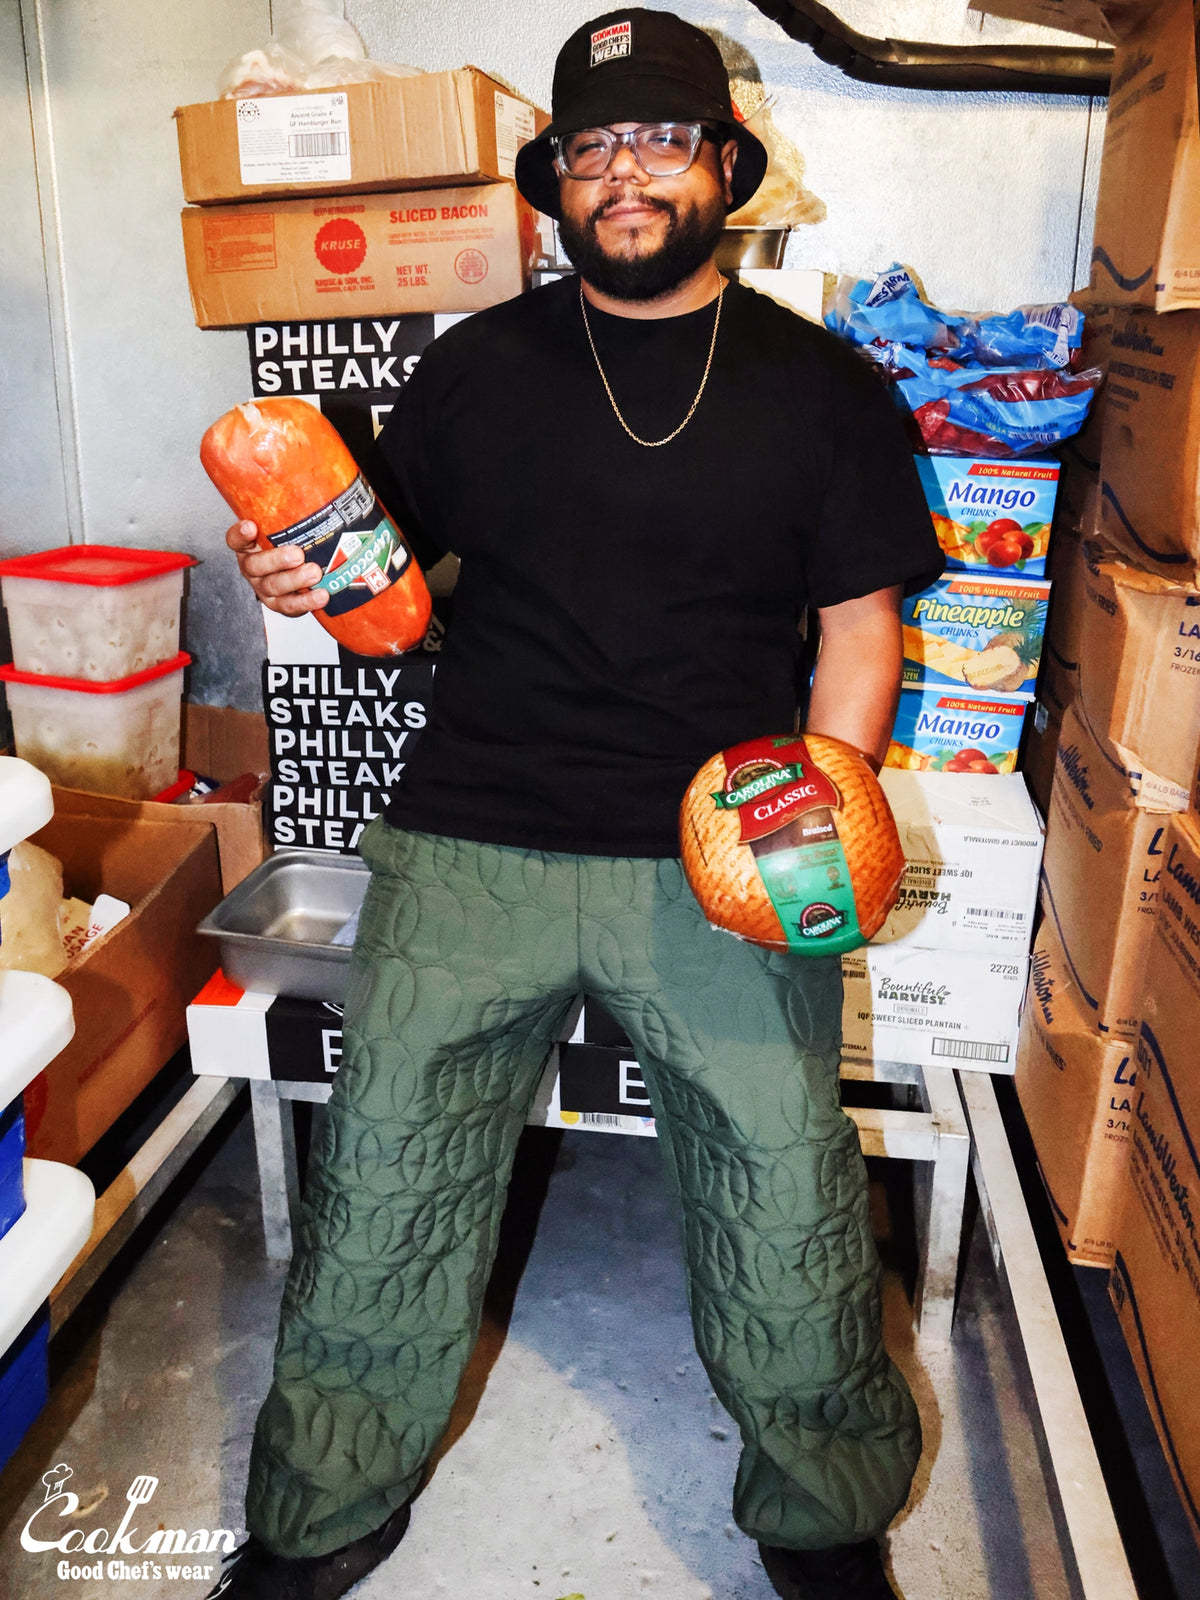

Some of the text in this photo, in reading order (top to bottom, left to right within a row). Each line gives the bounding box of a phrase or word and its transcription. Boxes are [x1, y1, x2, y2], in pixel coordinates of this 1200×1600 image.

[593, 24, 629, 43] COOKMAN
[594, 44, 628, 62] WEAR
[298, 119, 329, 127] Hamburger
[389, 204, 488, 224] SLICED BACON
[321, 239, 361, 251] KRUSE
[396, 264, 431, 275] NET WT.
[397, 276, 429, 288] 25 LBS.
[255, 321, 400, 357] PHILLY
[978, 466, 1053, 479] 100% Natural Fruit
[948, 482, 1036, 509] Mango
[960, 507, 998, 518] CHUNKS
[328, 529, 391, 591] CAPOCOLLO
[958, 584, 1040, 599] 100% Natural Fruit
[912, 598, 1025, 629] Pineapple
[939, 626, 980, 638] CHUNKS
[267, 666, 402, 697] PHILLY
[269, 697, 427, 729] STEAKS
[945, 701, 1017, 714] 100% Natural Fruit
[917, 713, 1001, 741] Mango
[274, 728, 409, 759] PHILLY
[929, 736, 964, 748] CHUNKS
[726, 769, 792, 804] CAROLINA
[753, 784, 818, 821] CLASSIC
[802, 823, 833, 836] Braised
[963, 835, 1001, 845] GUATEMALA
[1010, 839, 1038, 847] PRODUCT
[932, 868, 958, 878] SWEET
[959, 869, 973, 878] IQF
[990, 963, 1019, 975] 22728
[881, 977, 947, 996] Bountiful
[878, 990, 945, 1005] HARVEST
[858, 1012, 870, 1020] IQF
[871, 1013, 896, 1022] SWEET
[897, 1015, 924, 1025] SLICED
[925, 1020, 962, 1030] PLANTAIN
